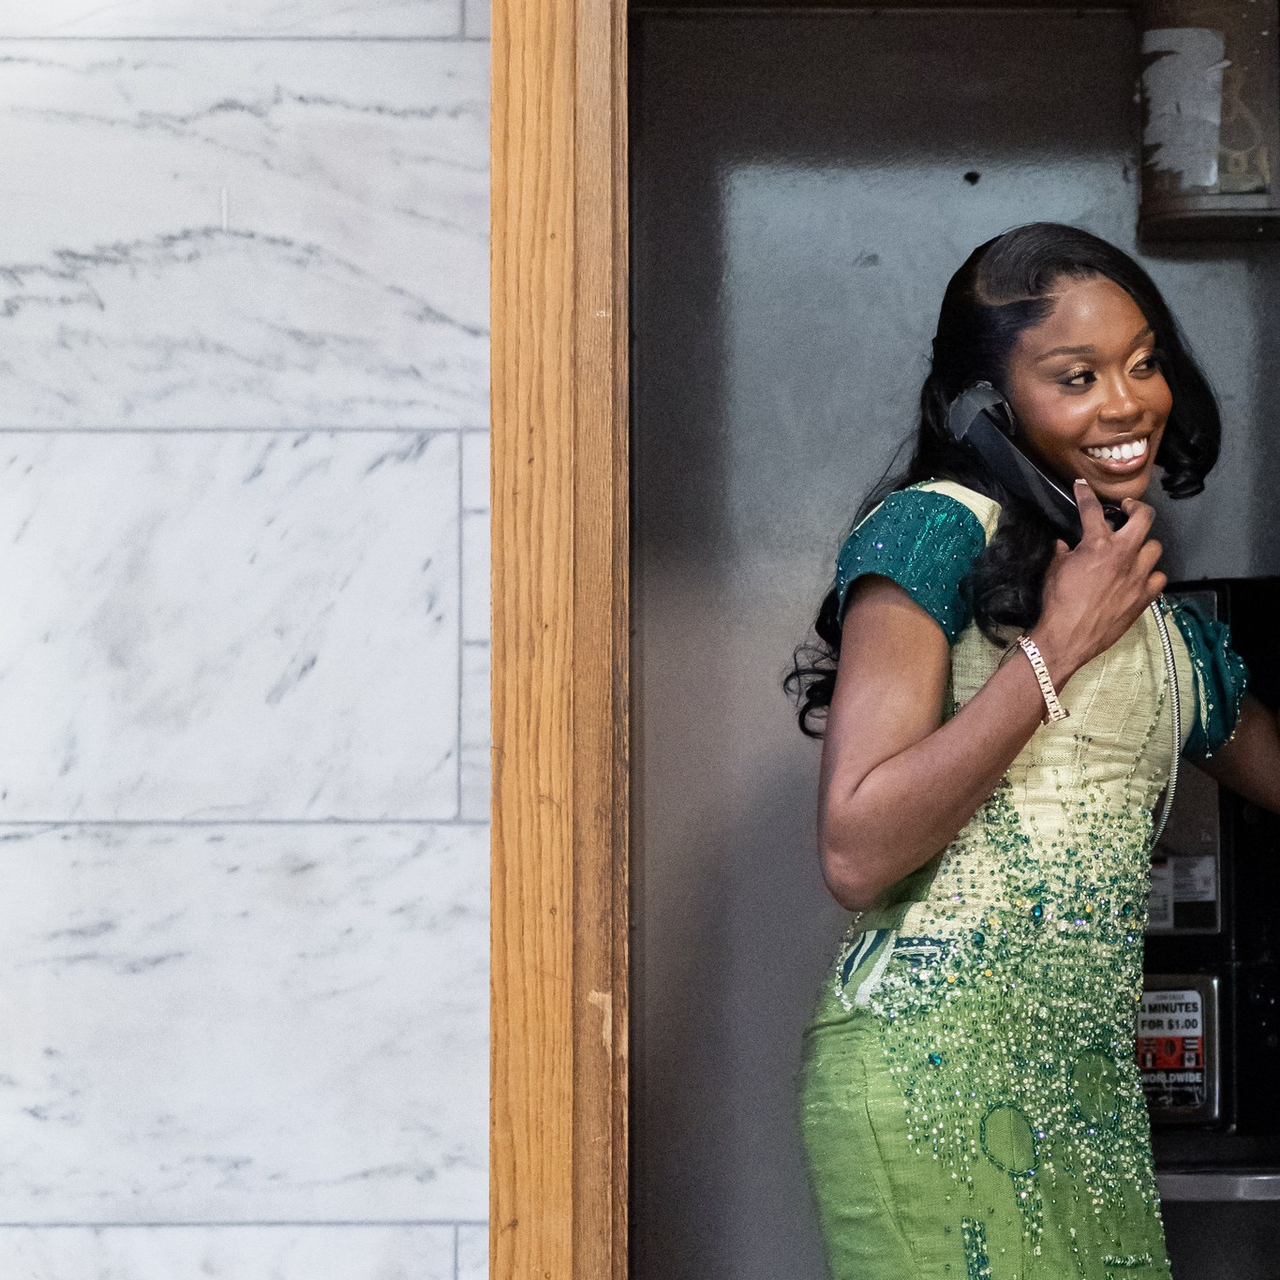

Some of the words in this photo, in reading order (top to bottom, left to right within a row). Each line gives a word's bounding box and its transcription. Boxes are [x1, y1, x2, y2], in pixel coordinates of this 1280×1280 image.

[1148, 1002, 1199, 1013] MINUTES
[1141, 1019, 1164, 1030] FOR
[1167, 1018, 1198, 1030] $1.00
